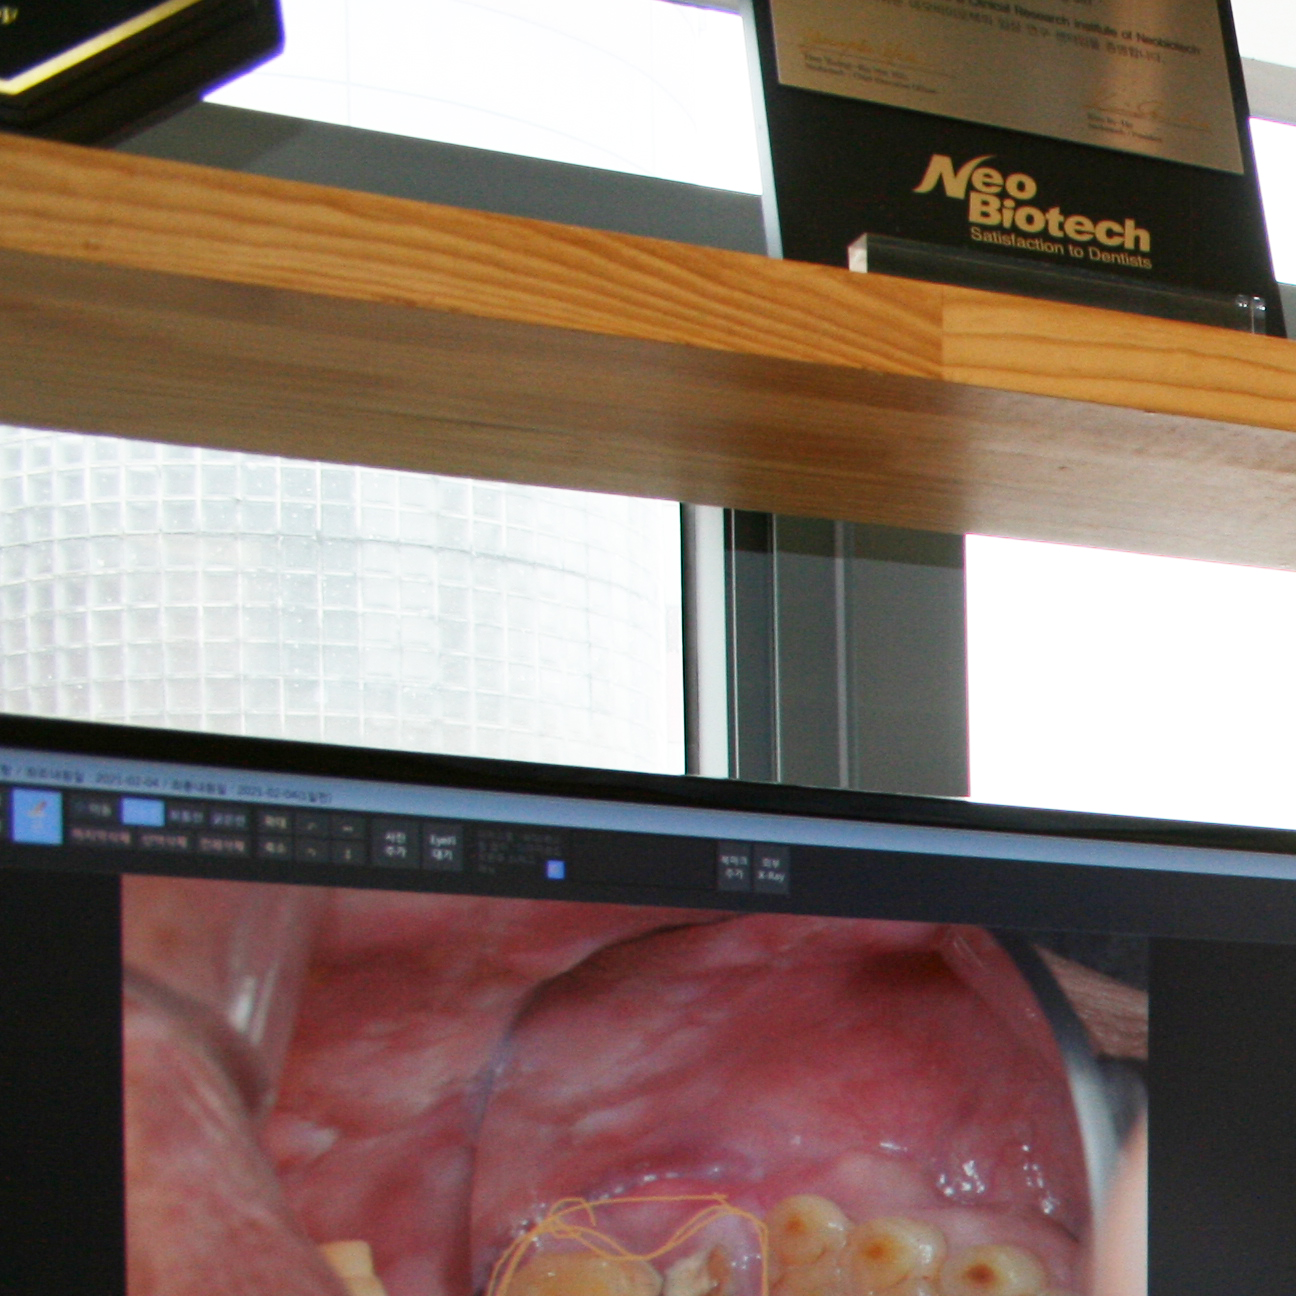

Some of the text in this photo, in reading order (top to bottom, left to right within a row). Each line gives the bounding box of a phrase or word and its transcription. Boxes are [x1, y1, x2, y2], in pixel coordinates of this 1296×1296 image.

[913, 153, 1037, 200] Neo
[968, 190, 1150, 252] Biotech
[970, 225, 1152, 269] Satisfaction to Dentists
